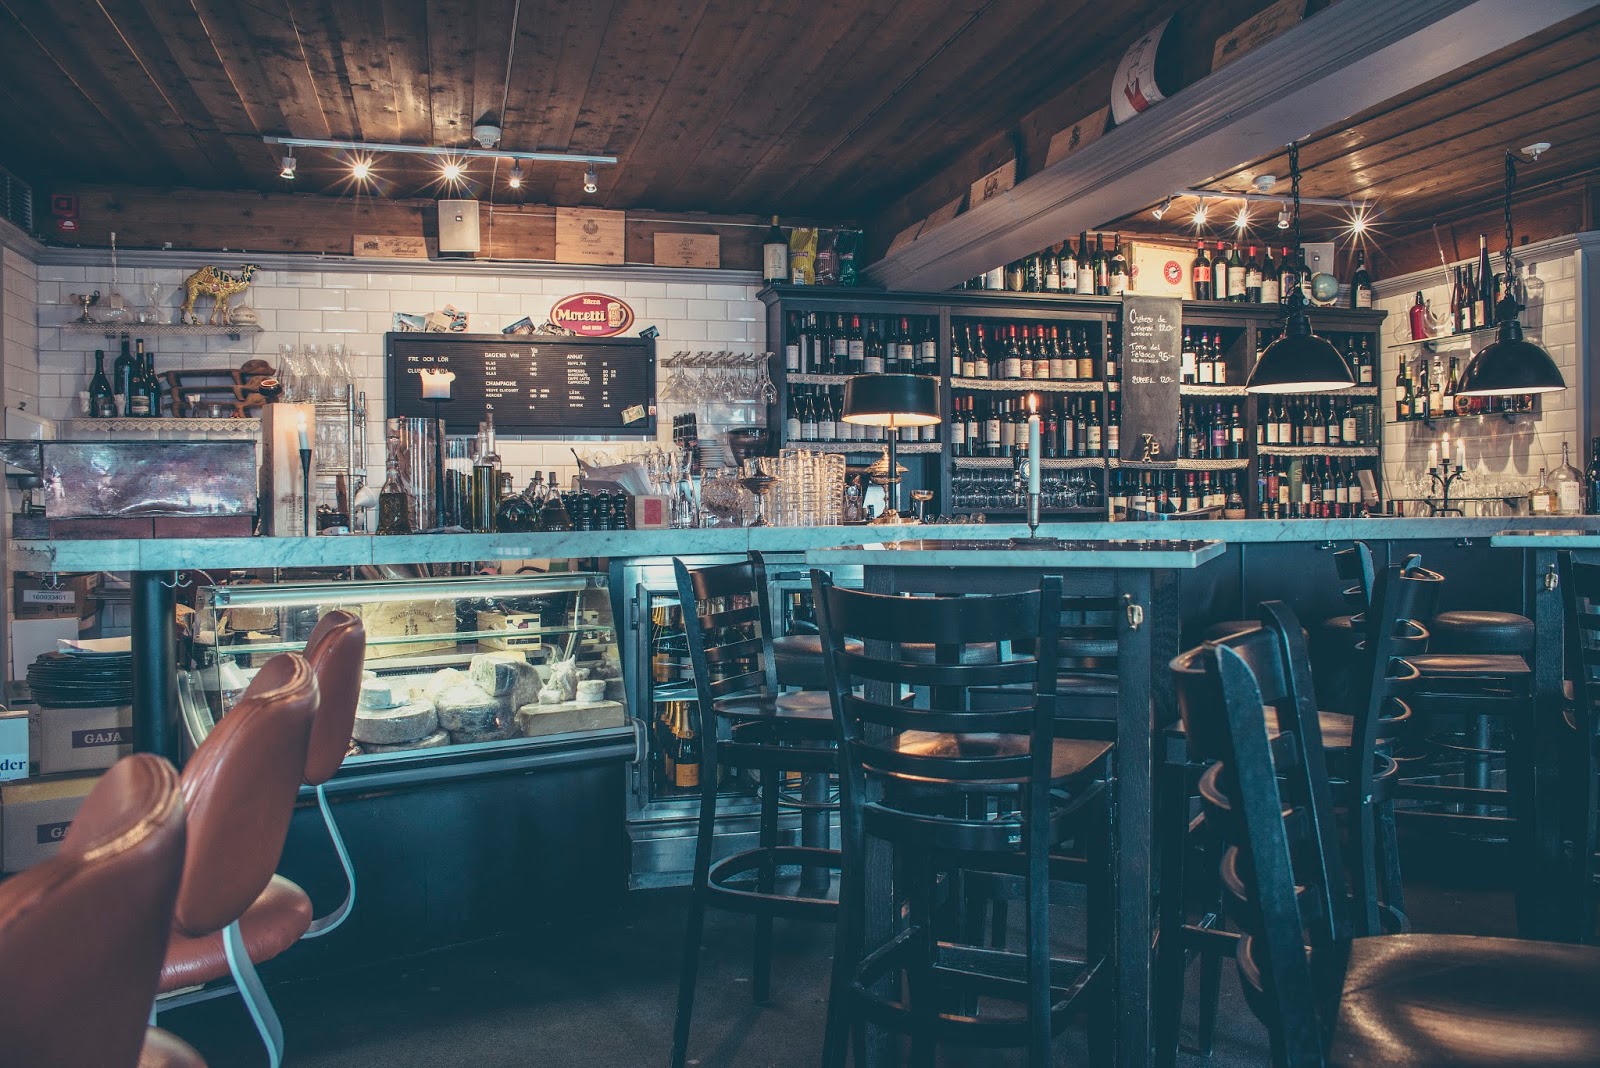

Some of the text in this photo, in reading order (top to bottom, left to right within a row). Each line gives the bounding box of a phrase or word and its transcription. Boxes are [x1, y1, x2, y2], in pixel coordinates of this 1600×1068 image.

[557, 309, 606, 322] Moretti
[438, 355, 449, 363] LÖR
[1294, 468, 1302, 482] Vin
[84, 731, 123, 744] GAJA
